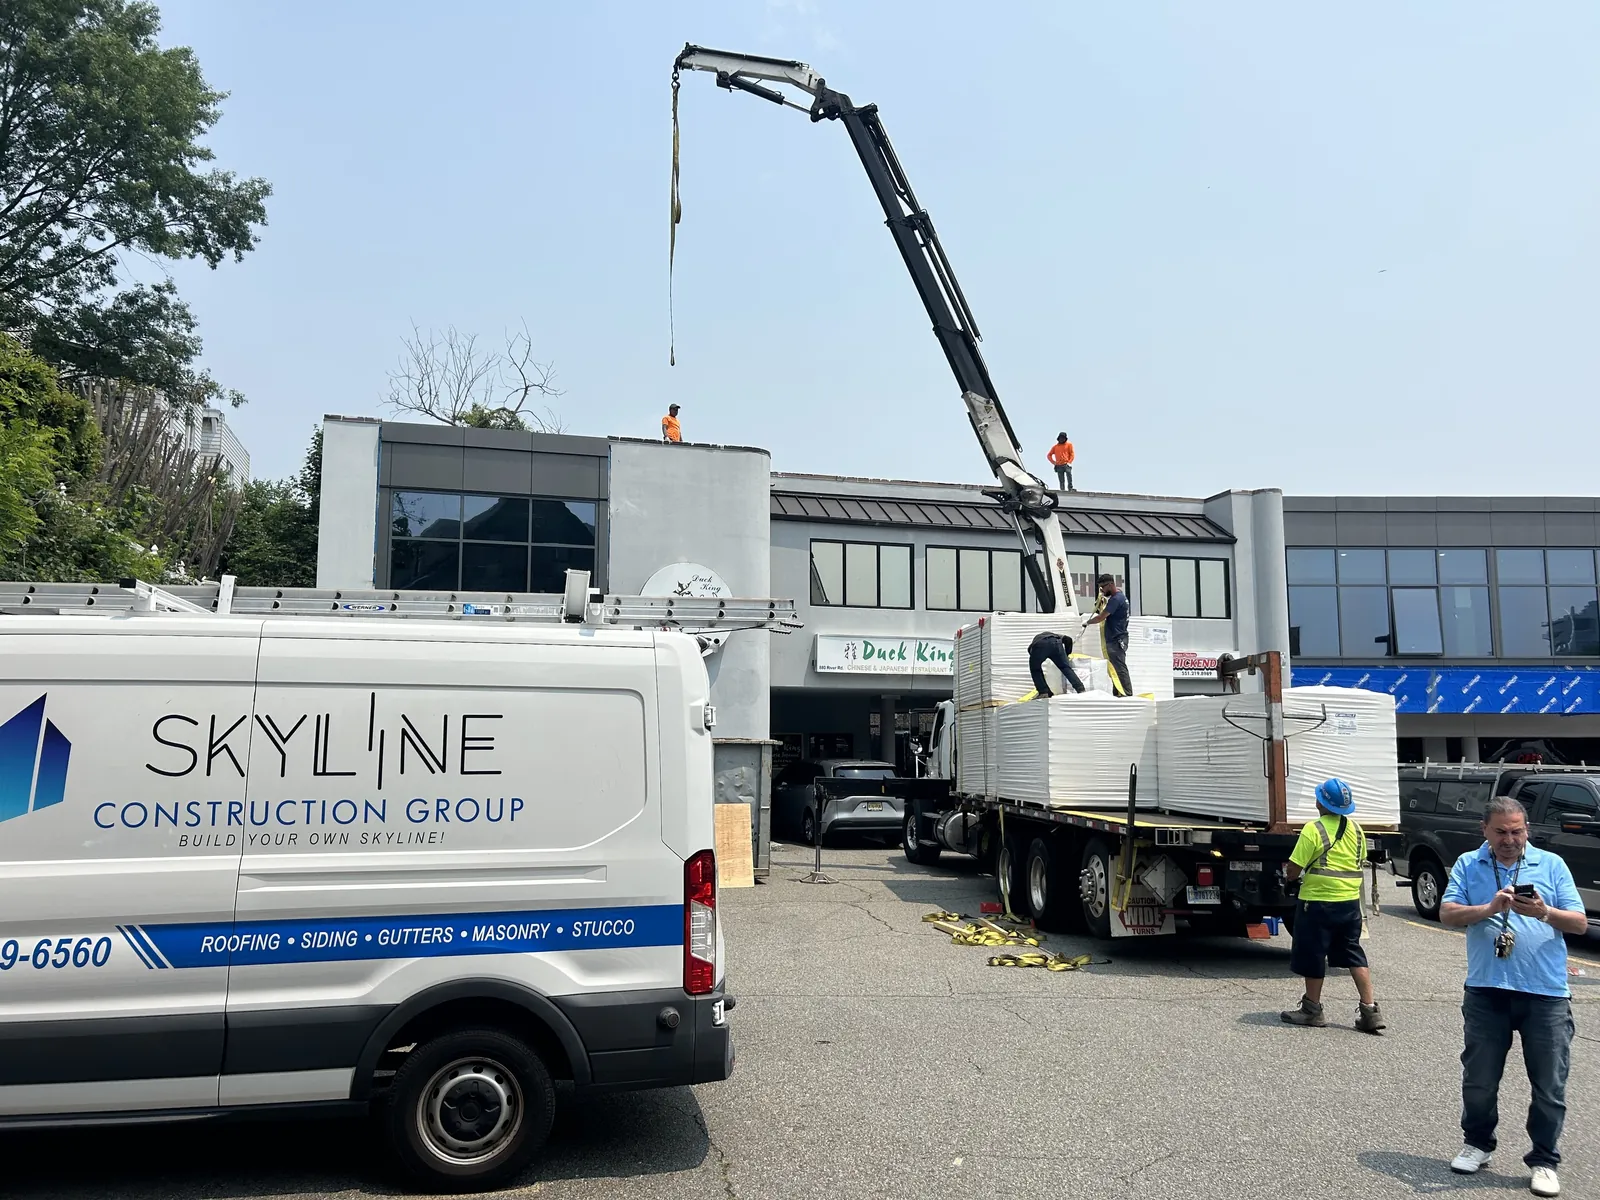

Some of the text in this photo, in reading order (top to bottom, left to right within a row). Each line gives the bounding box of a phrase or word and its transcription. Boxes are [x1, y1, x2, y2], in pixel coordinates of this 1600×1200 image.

[691, 573, 713, 583] Duck
[700, 583, 721, 593] King
[862, 640, 907, 661] Duck
[145, 691, 504, 791] SKYLINE
[93, 797, 524, 829] CONSTRUCTION GROUP
[178, 831, 446, 847] BUILD YOUR OWN SKYLINE!
[1127, 897, 1156, 905] CAUTION
[1125, 906, 1163, 926] WIDE
[200, 919, 635, 953] ROOFING SIDING GUTTERS MASONRY STUCCO
[1131, 927, 1156, 935] TURNS
[0, 936, 112, 971] 9-6560
